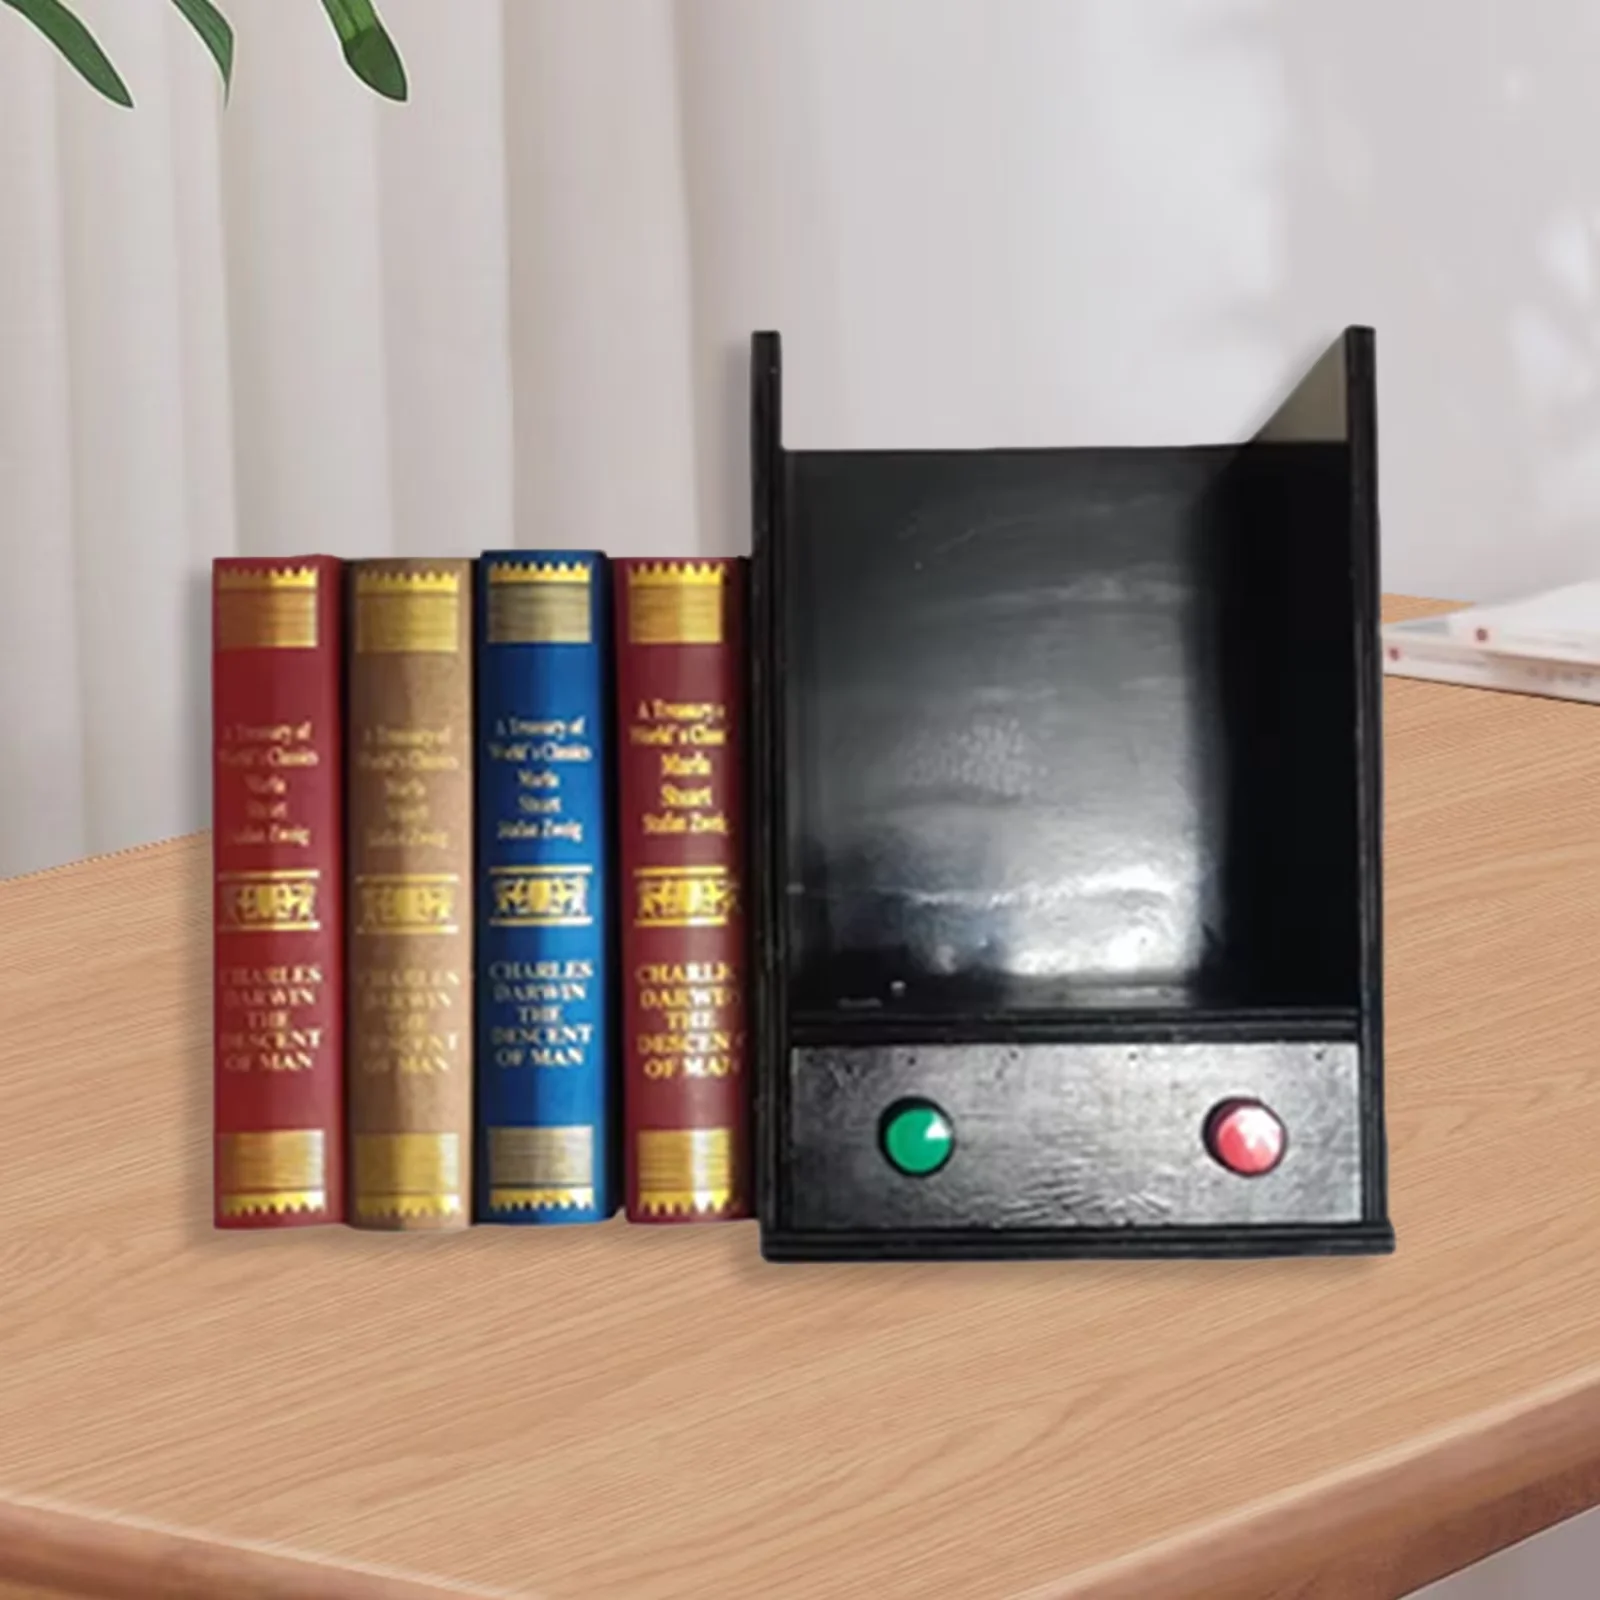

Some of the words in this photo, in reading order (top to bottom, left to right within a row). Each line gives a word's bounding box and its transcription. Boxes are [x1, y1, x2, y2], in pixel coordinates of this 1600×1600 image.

[488, 961, 594, 980] CHARLES
[493, 983, 587, 1003] DARWIN
[517, 1004, 564, 1024] THE
[664, 1010, 717, 1031] THE
[491, 1024, 594, 1047] DESCENT
[495, 1048, 525, 1069] OF
[530, 1047, 585, 1068] MAN
[643, 1057, 678, 1079] OF
